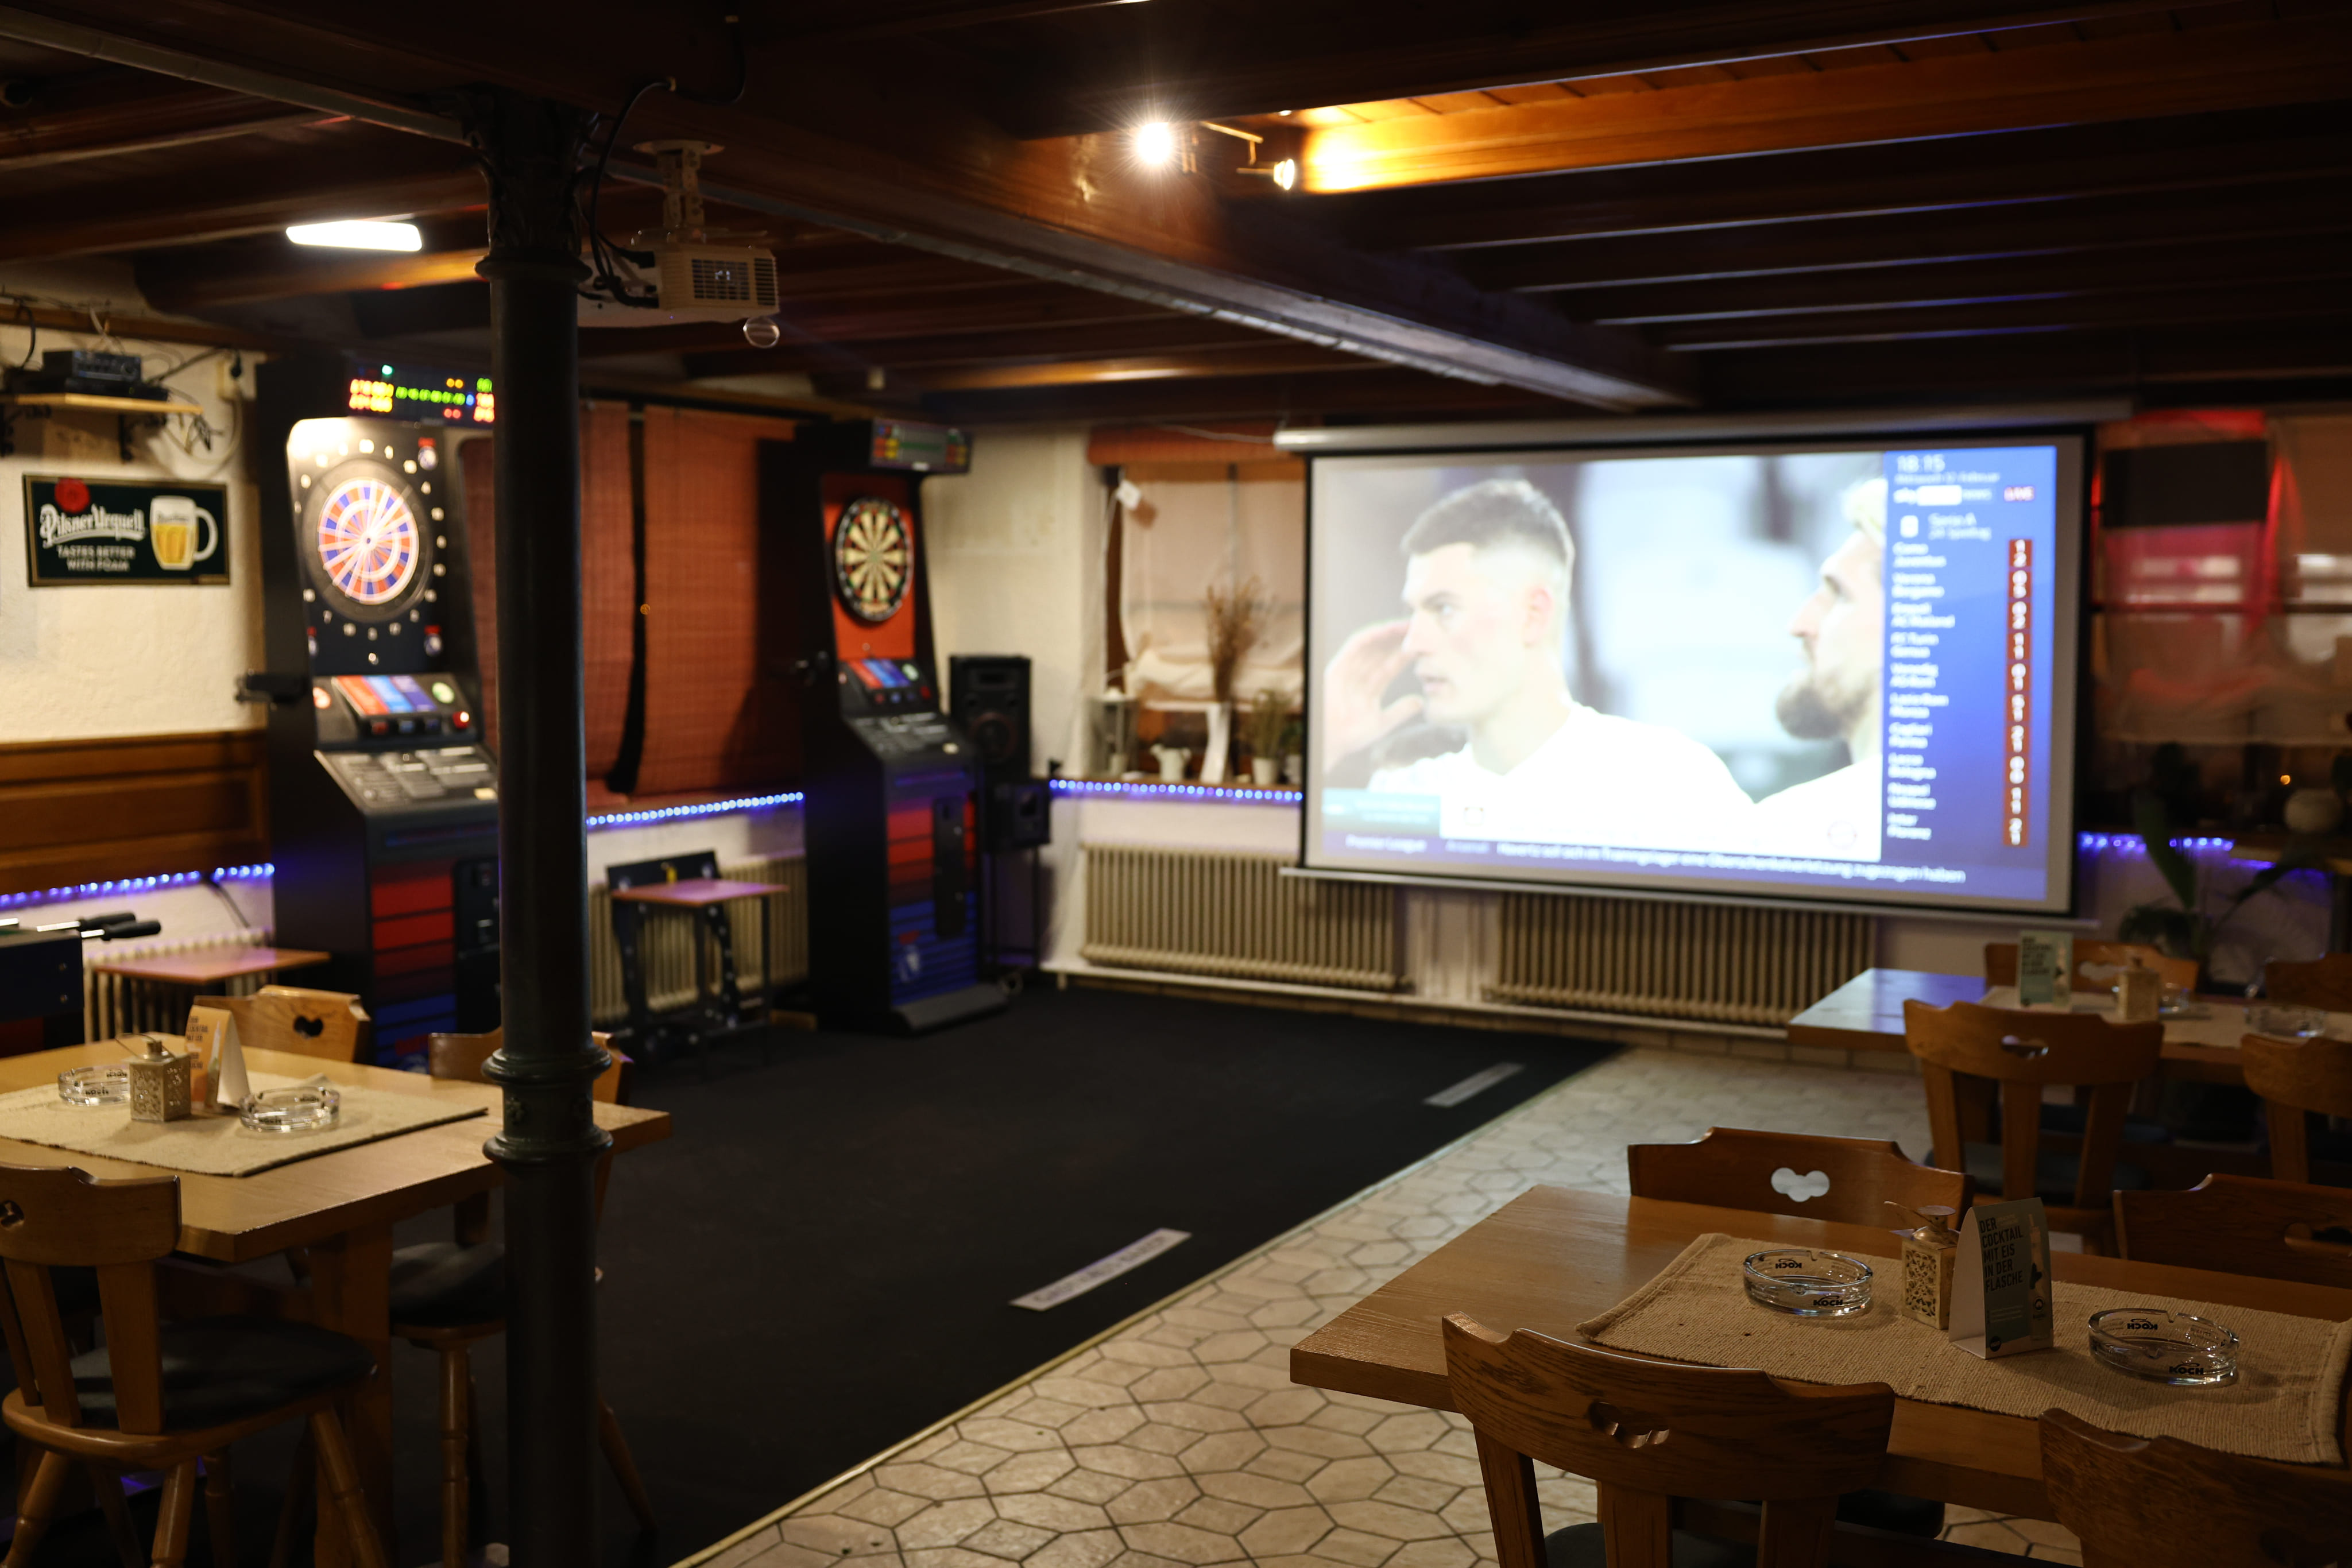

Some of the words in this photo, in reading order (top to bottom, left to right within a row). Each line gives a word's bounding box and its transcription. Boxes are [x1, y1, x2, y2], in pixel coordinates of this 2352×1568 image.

[40, 504, 94, 548] Pilsner
[91, 503, 145, 541] Urquell
[57, 545, 95, 559] TASTES
[96, 545, 135, 559] BETTER
[67, 559, 95, 571] WITH
[96, 560, 130, 572] FOAM
[1979, 1217, 1997, 1233] DER
[1982, 1226, 2023, 1248] COCKTAIL
[1983, 1247, 1999, 1263] MIT
[2002, 1244, 2015, 1257] EIS
[1985, 1264, 1994, 1278] IN
[1997, 1259, 2013, 1275] DER
[1986, 1271, 2022, 1292] FLASCHE
[2169, 1366, 2204, 1375] KOCH
